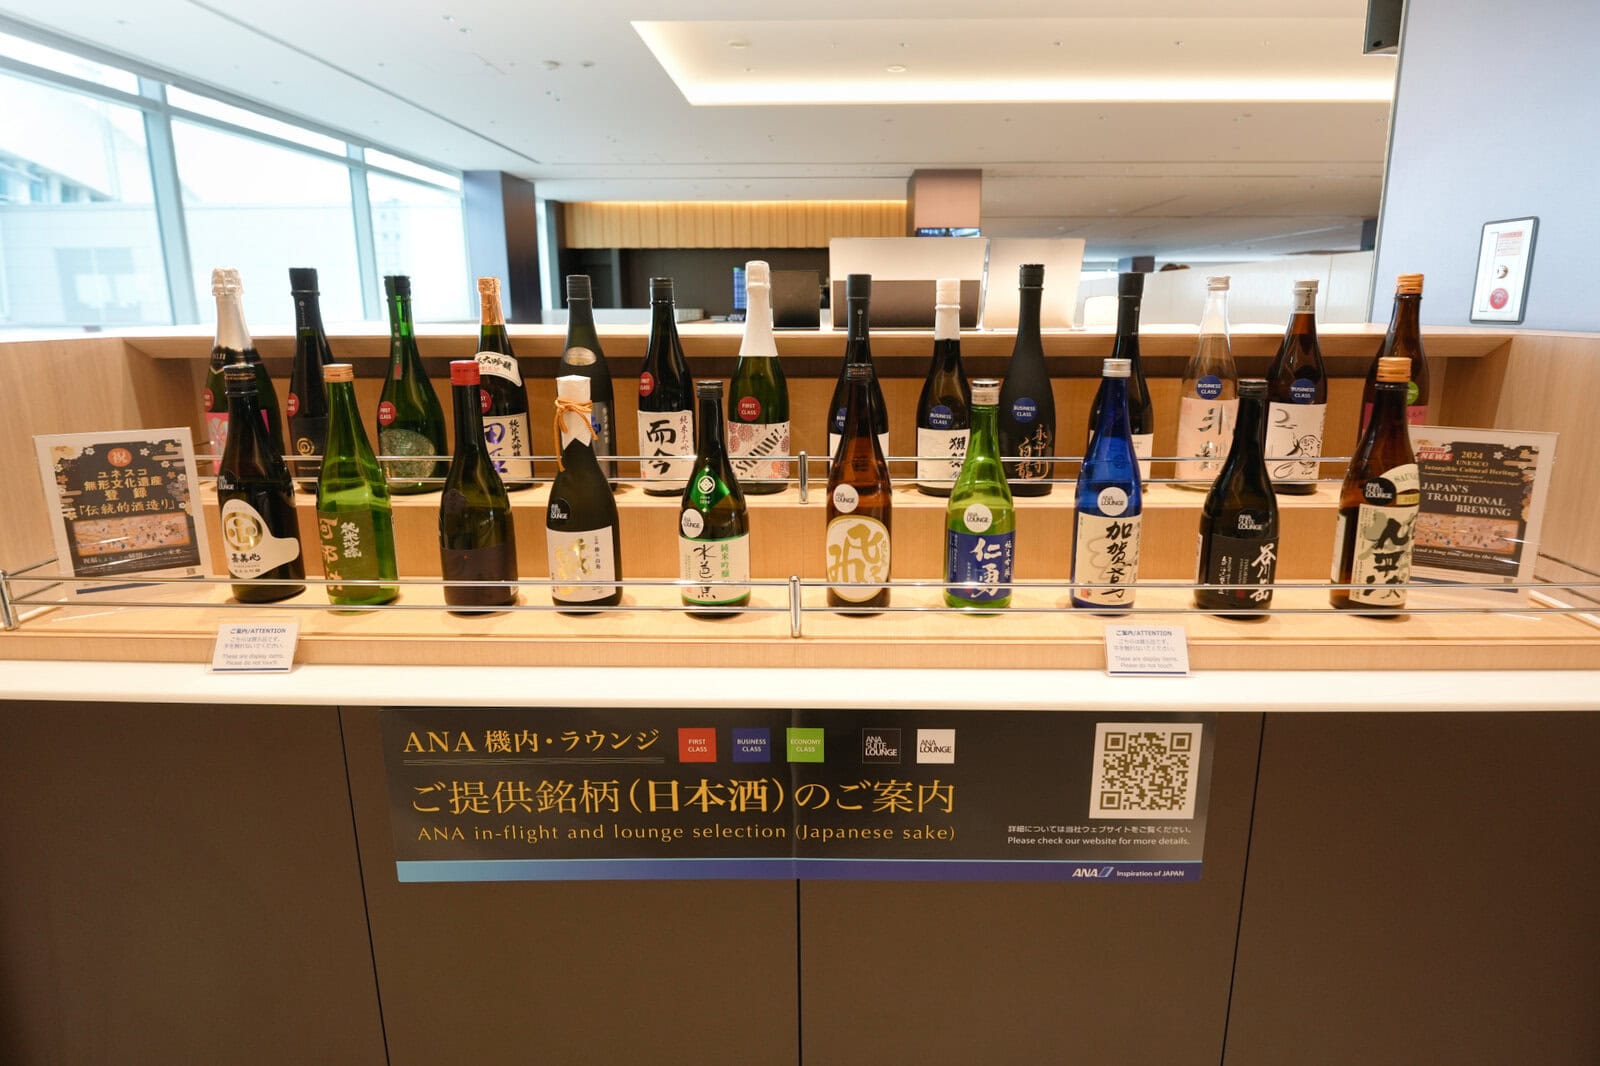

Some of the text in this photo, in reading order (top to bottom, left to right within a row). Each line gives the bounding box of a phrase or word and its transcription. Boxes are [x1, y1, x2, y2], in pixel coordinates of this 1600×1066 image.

[112, 452, 129, 464] 祝
[1420, 453, 1451, 461] NEWS
[1461, 451, 1483, 459] 2024
[97, 468, 147, 479] ユネスコ
[1459, 466, 1488, 474] Cultural
[84, 476, 163, 491] 無形文化遺産
[1427, 492, 1506, 507] TRADITIONAL
[1456, 504, 1512, 517] BREWING
[404, 729, 660, 753] ANA 機内・ラウンジ
[920, 739, 936, 747] ANA
[865, 748, 897, 757] LOUNGE
[919, 746, 952, 754] LOUNGE
[418, 824, 955, 844] ANA in-flight and lounge selection (Japanese sake)
[1008, 836, 1035, 844] Please
[1038, 836, 1064, 844] check
[1083, 836, 1116, 845] website
[1119, 836, 1131, 845] for
[1133, 838, 1157, 846] more
[1158, 836, 1190, 846] details.
[1072, 867, 1098, 877] ANA
[1117, 870, 1152, 878] Inspiration
